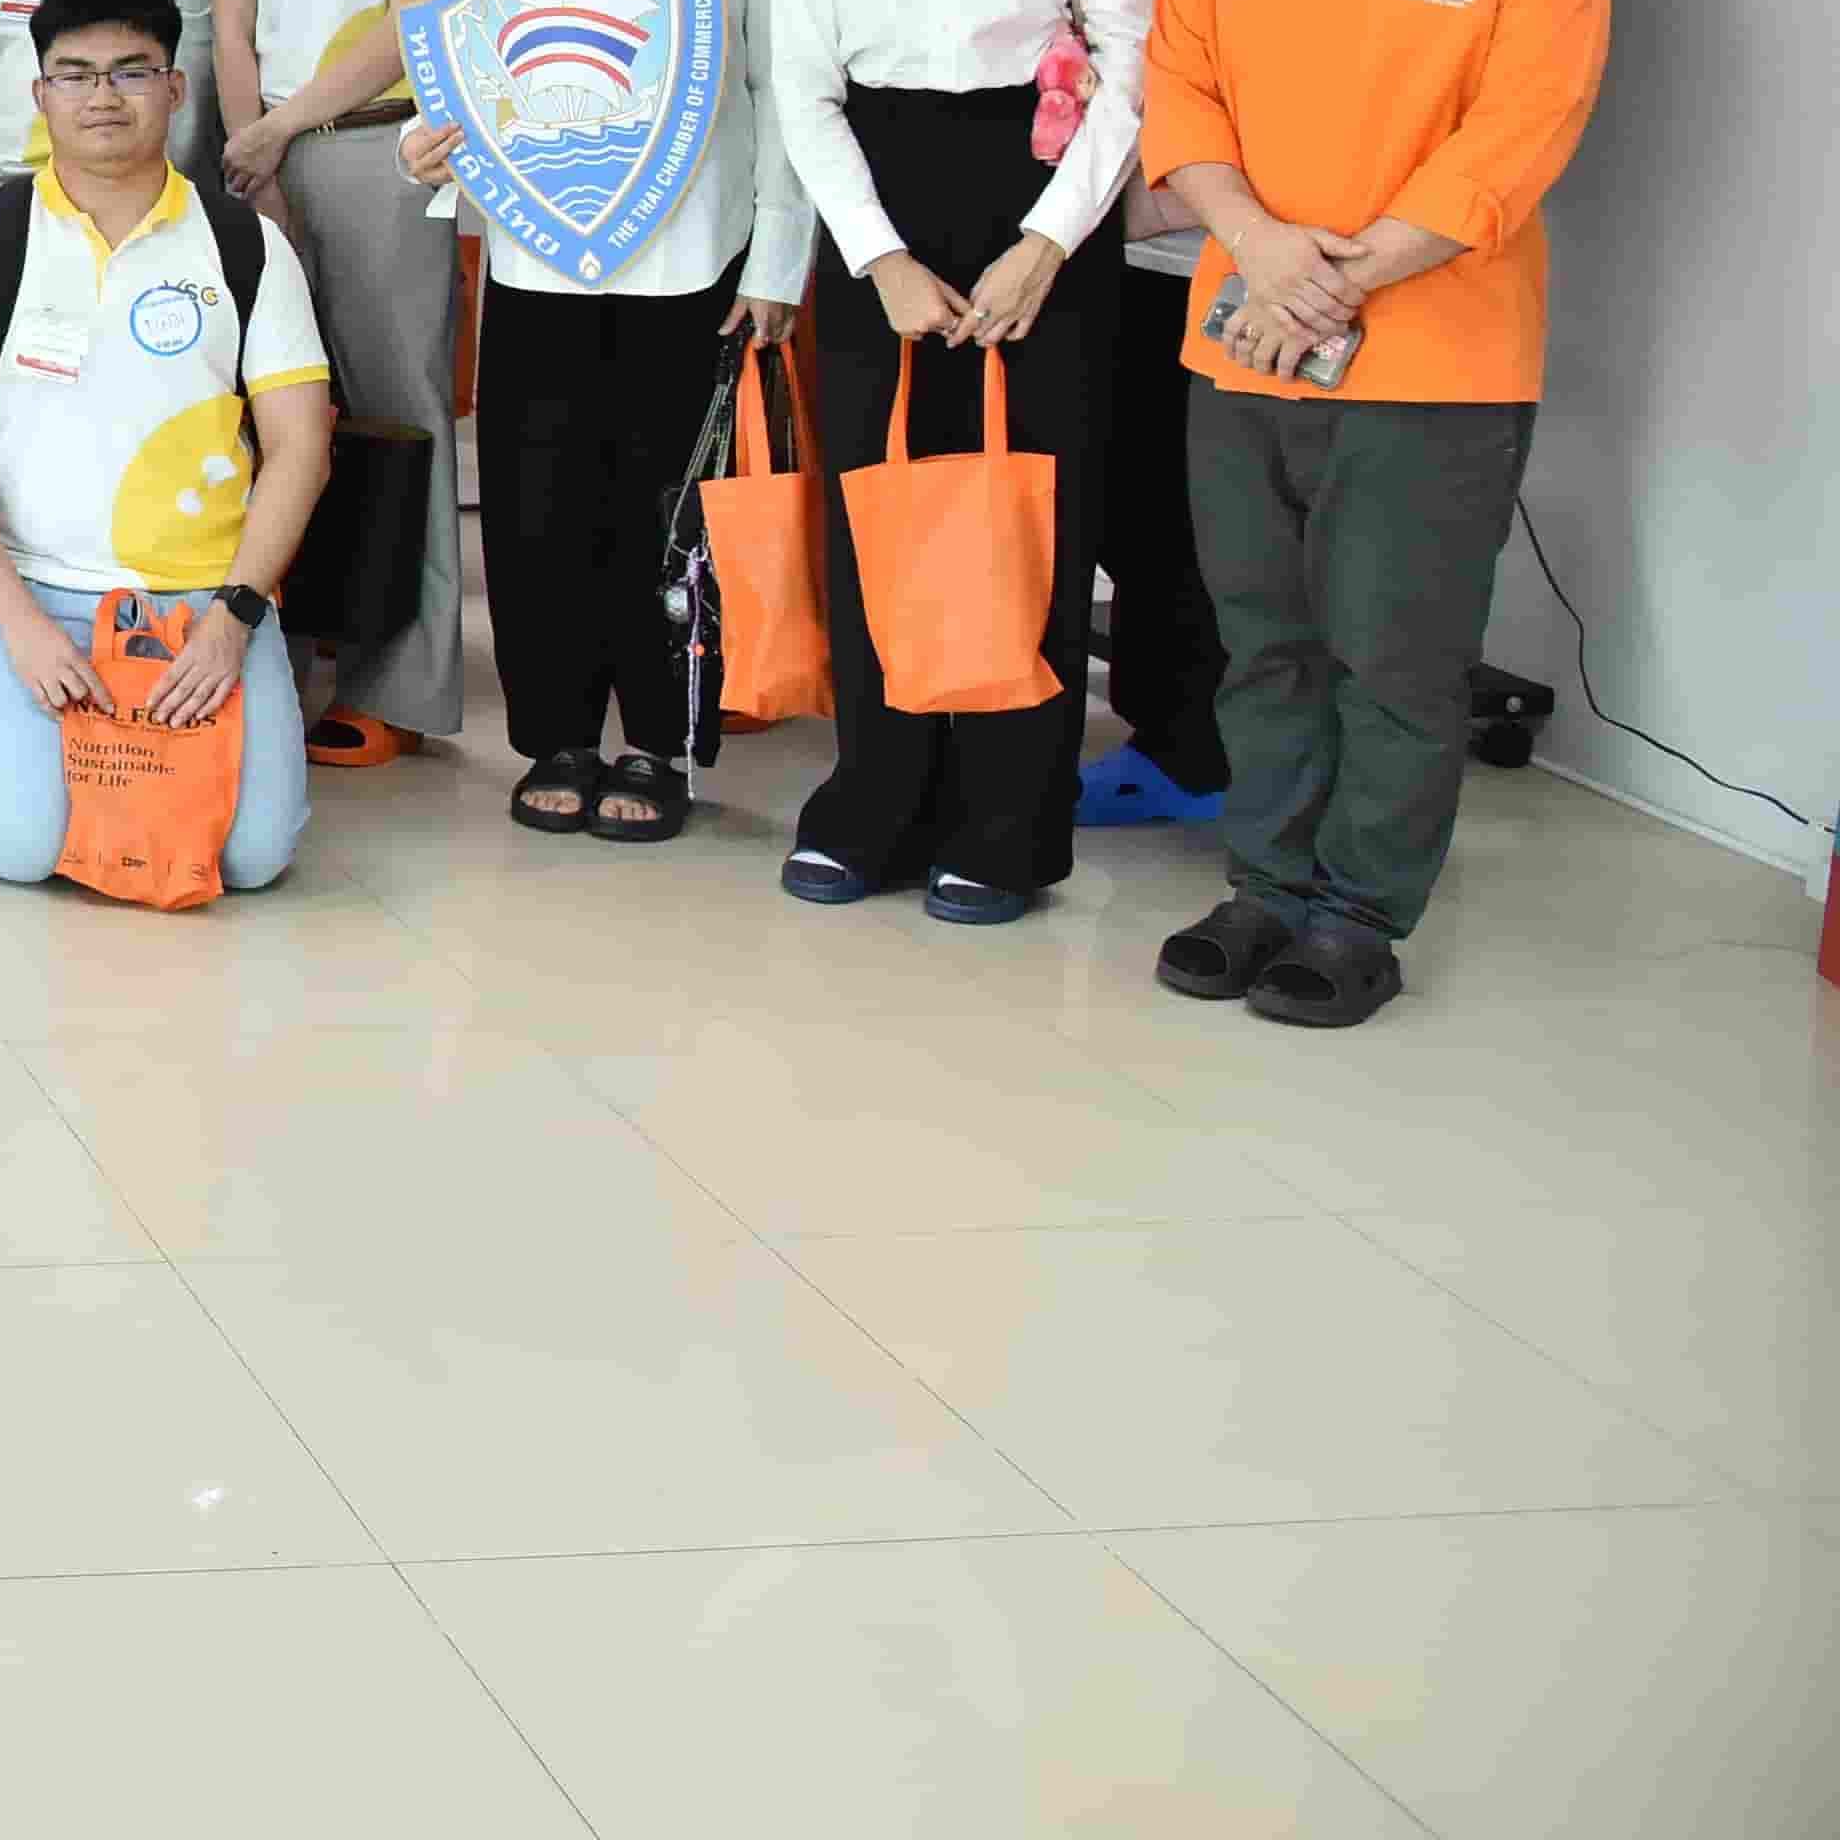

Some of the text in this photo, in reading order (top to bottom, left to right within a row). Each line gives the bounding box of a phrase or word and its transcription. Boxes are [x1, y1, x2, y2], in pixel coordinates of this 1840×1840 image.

[607, 217, 640, 250] THE
[631, 184, 666, 223] THAI
[655, 111, 700, 188] CHAMBER
[685, 84, 706, 107] OF
[70, 737, 155, 758] Nutrition
[68, 753, 177, 776] Sustainable
[97, 773, 134, 789] Life
